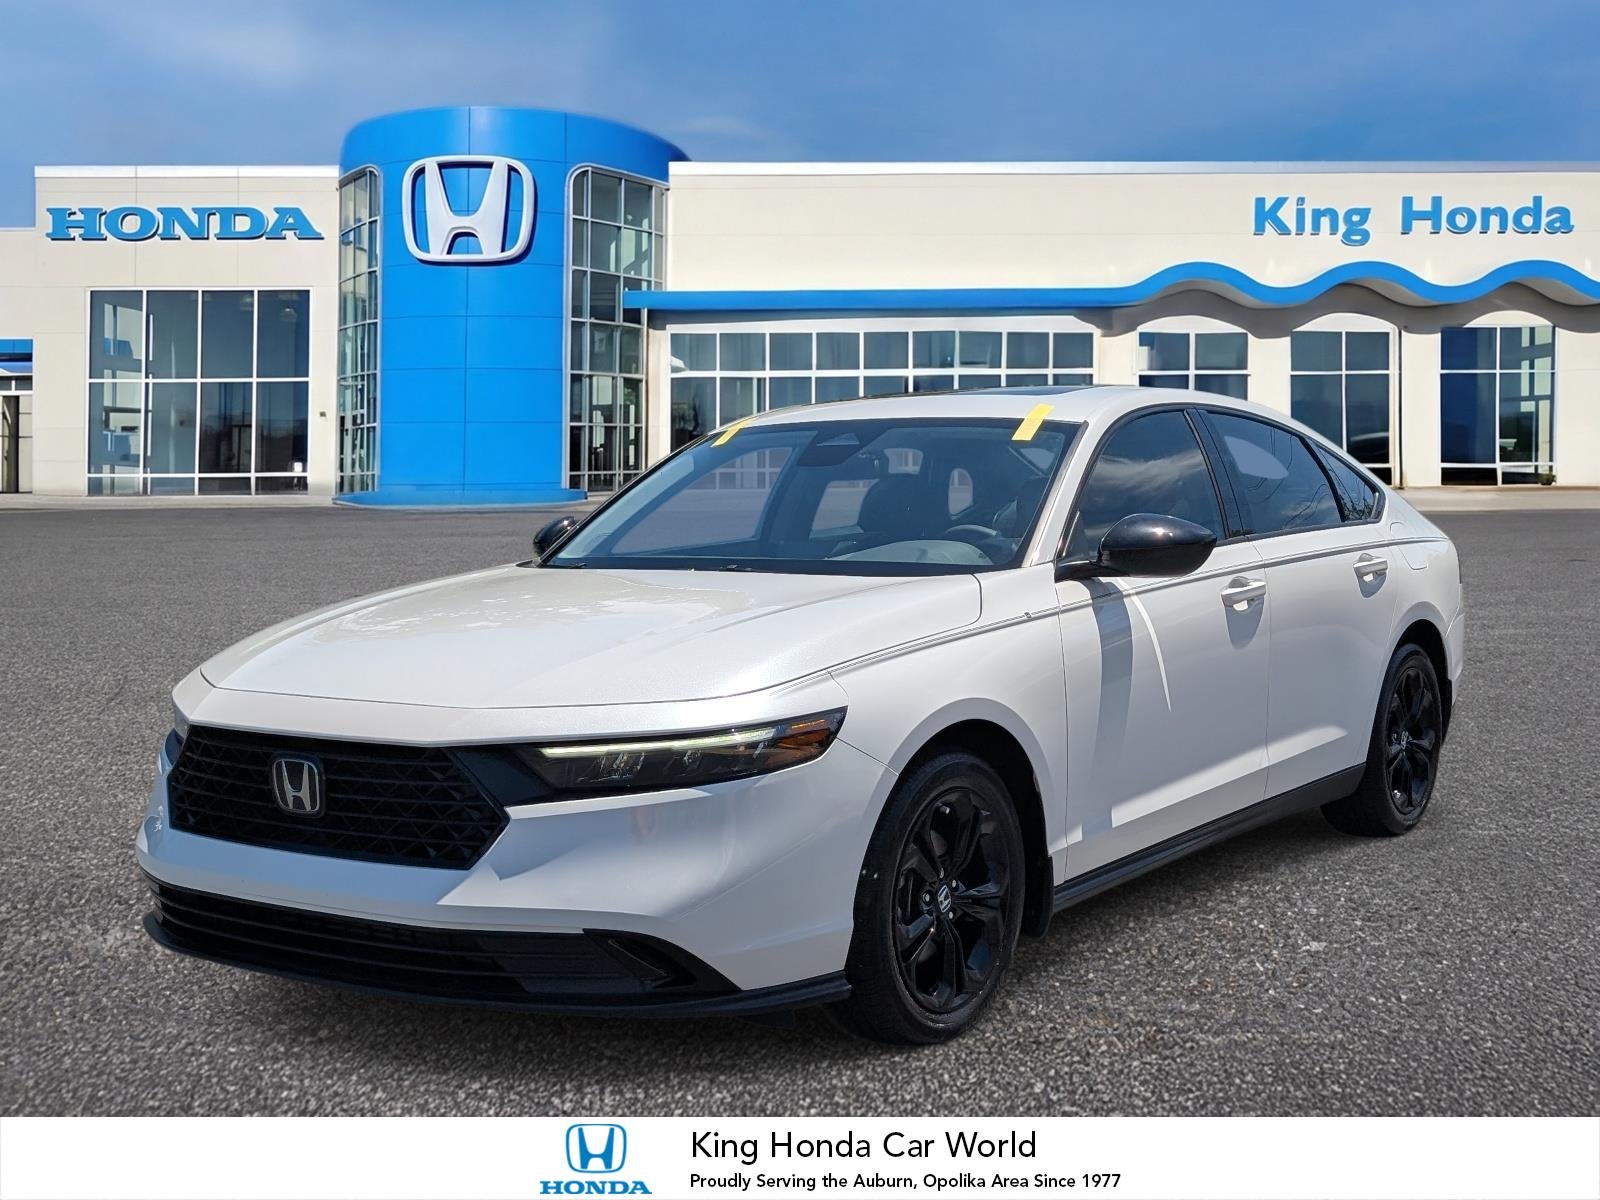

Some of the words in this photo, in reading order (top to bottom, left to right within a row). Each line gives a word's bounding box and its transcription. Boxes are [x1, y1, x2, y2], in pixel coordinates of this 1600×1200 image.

[45, 206, 324, 241] HONDA
[1253, 196, 1372, 246] King
[1400, 195, 1575, 234] Honda
